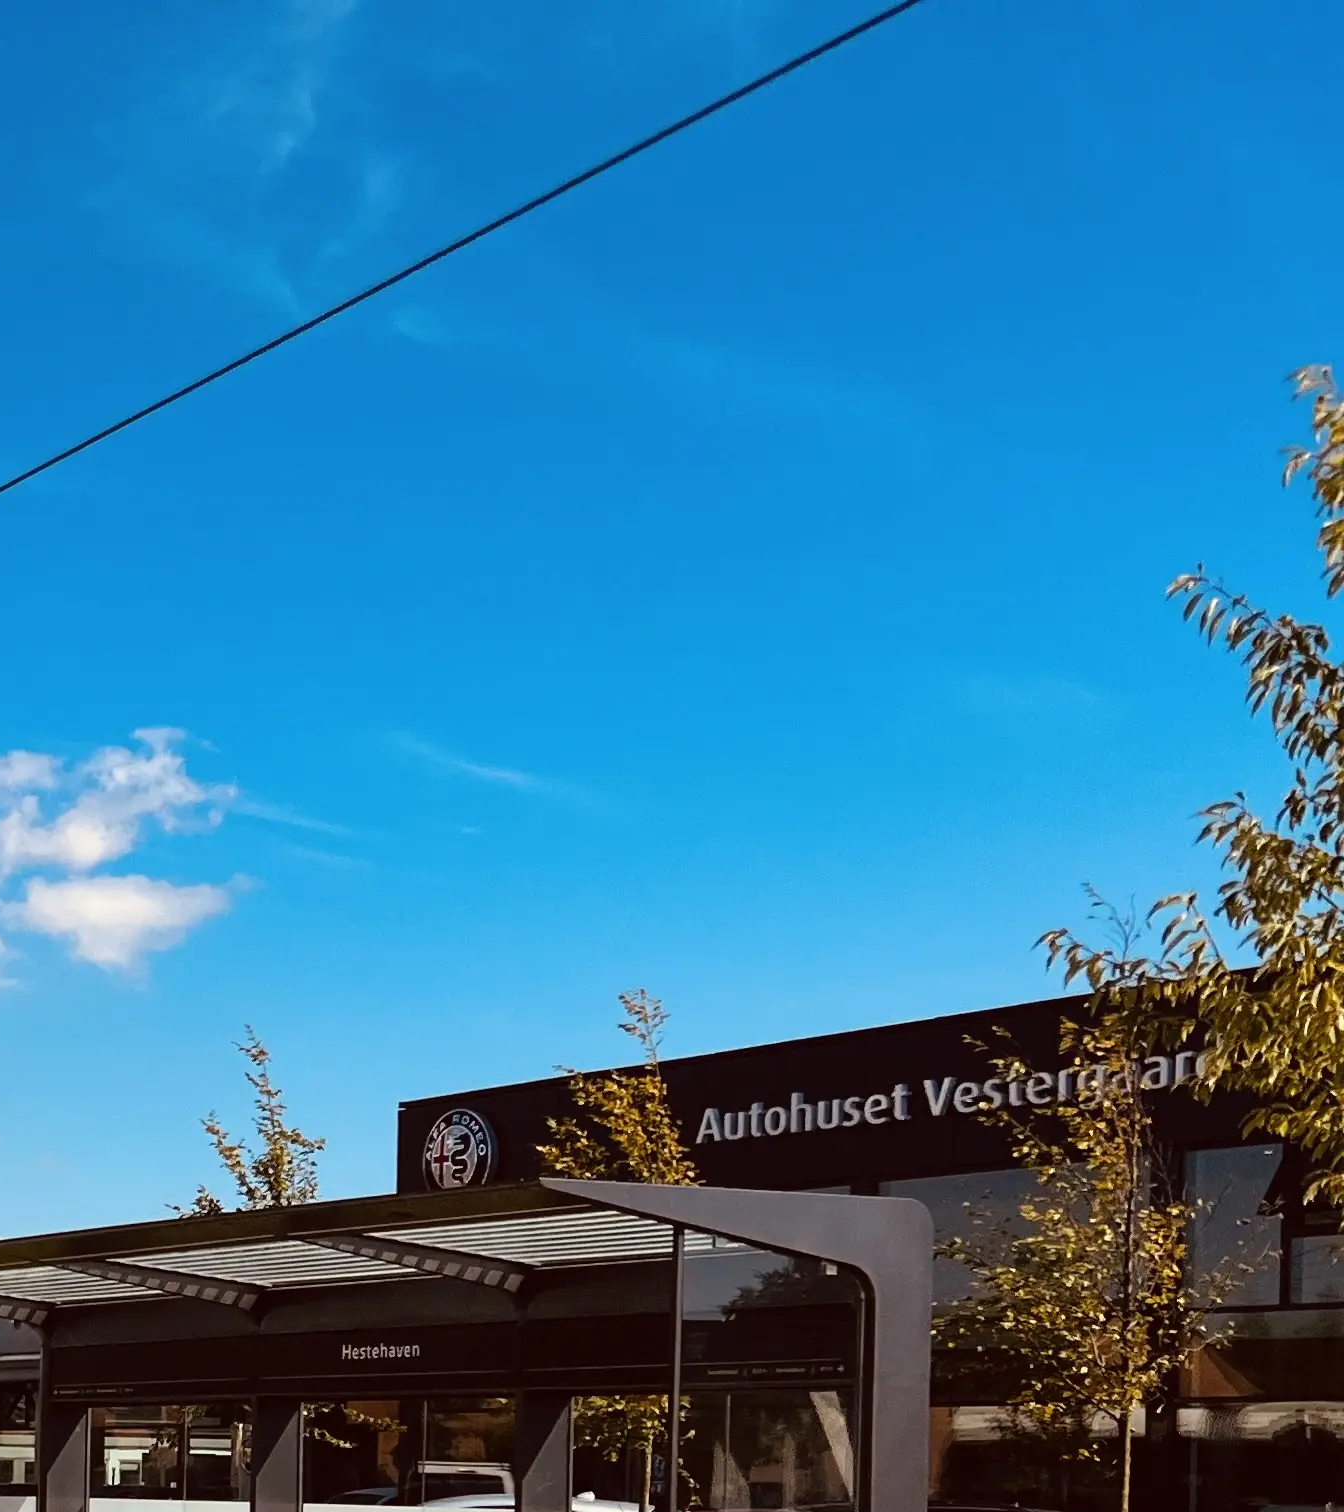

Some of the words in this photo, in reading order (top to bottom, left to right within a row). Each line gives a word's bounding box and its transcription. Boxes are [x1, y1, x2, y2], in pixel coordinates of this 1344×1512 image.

[696, 1083, 911, 1144] Autohuset
[452, 1114, 487, 1156] ROMEO
[341, 1343, 420, 1360] Hestehaven
